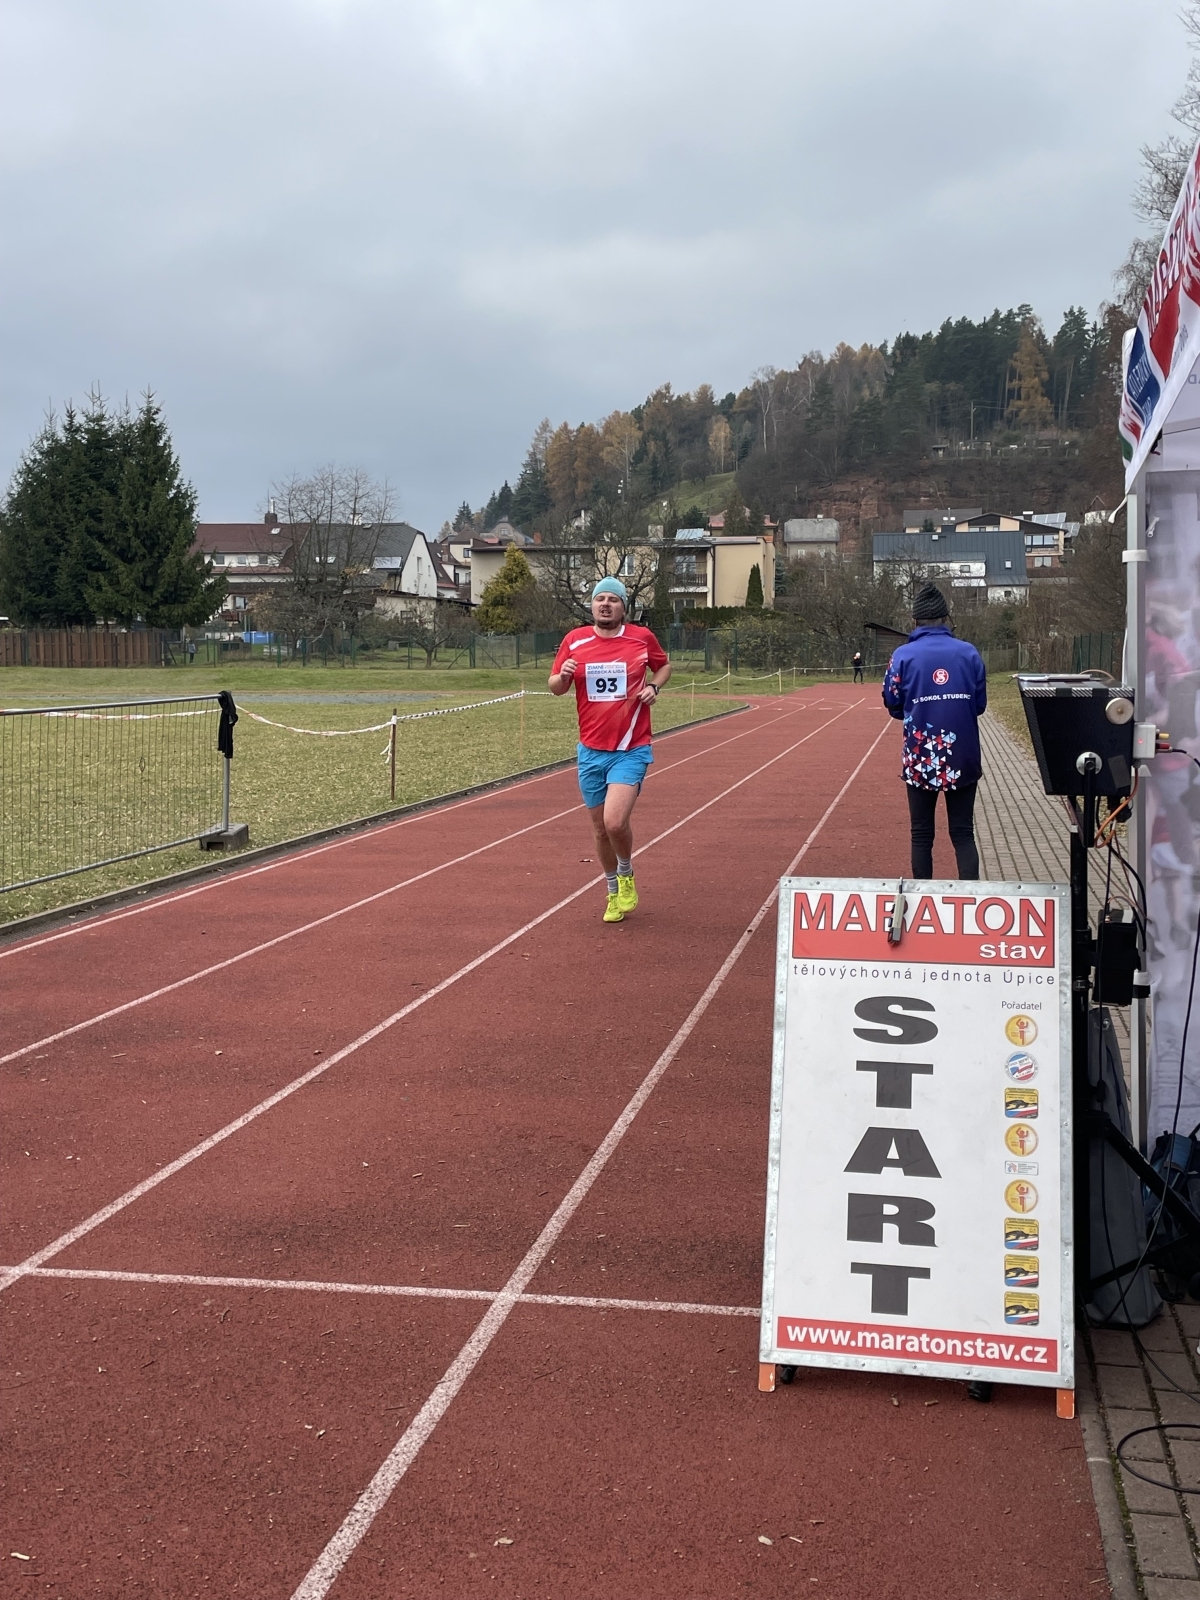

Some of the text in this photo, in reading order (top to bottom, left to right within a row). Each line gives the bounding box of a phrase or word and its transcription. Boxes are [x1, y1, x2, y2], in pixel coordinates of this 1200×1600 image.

[596, 678, 618, 693] 93
[794, 892, 1055, 938] MARATON
[979, 941, 1047, 960] stav
[793, 963, 1055, 986] tělovýchovná jednota Úpice
[1001, 1000, 1042, 1011] Pořadatel
[843, 995, 943, 1317] START
[786, 1324, 1048, 1365] www.maratonstav.cz
